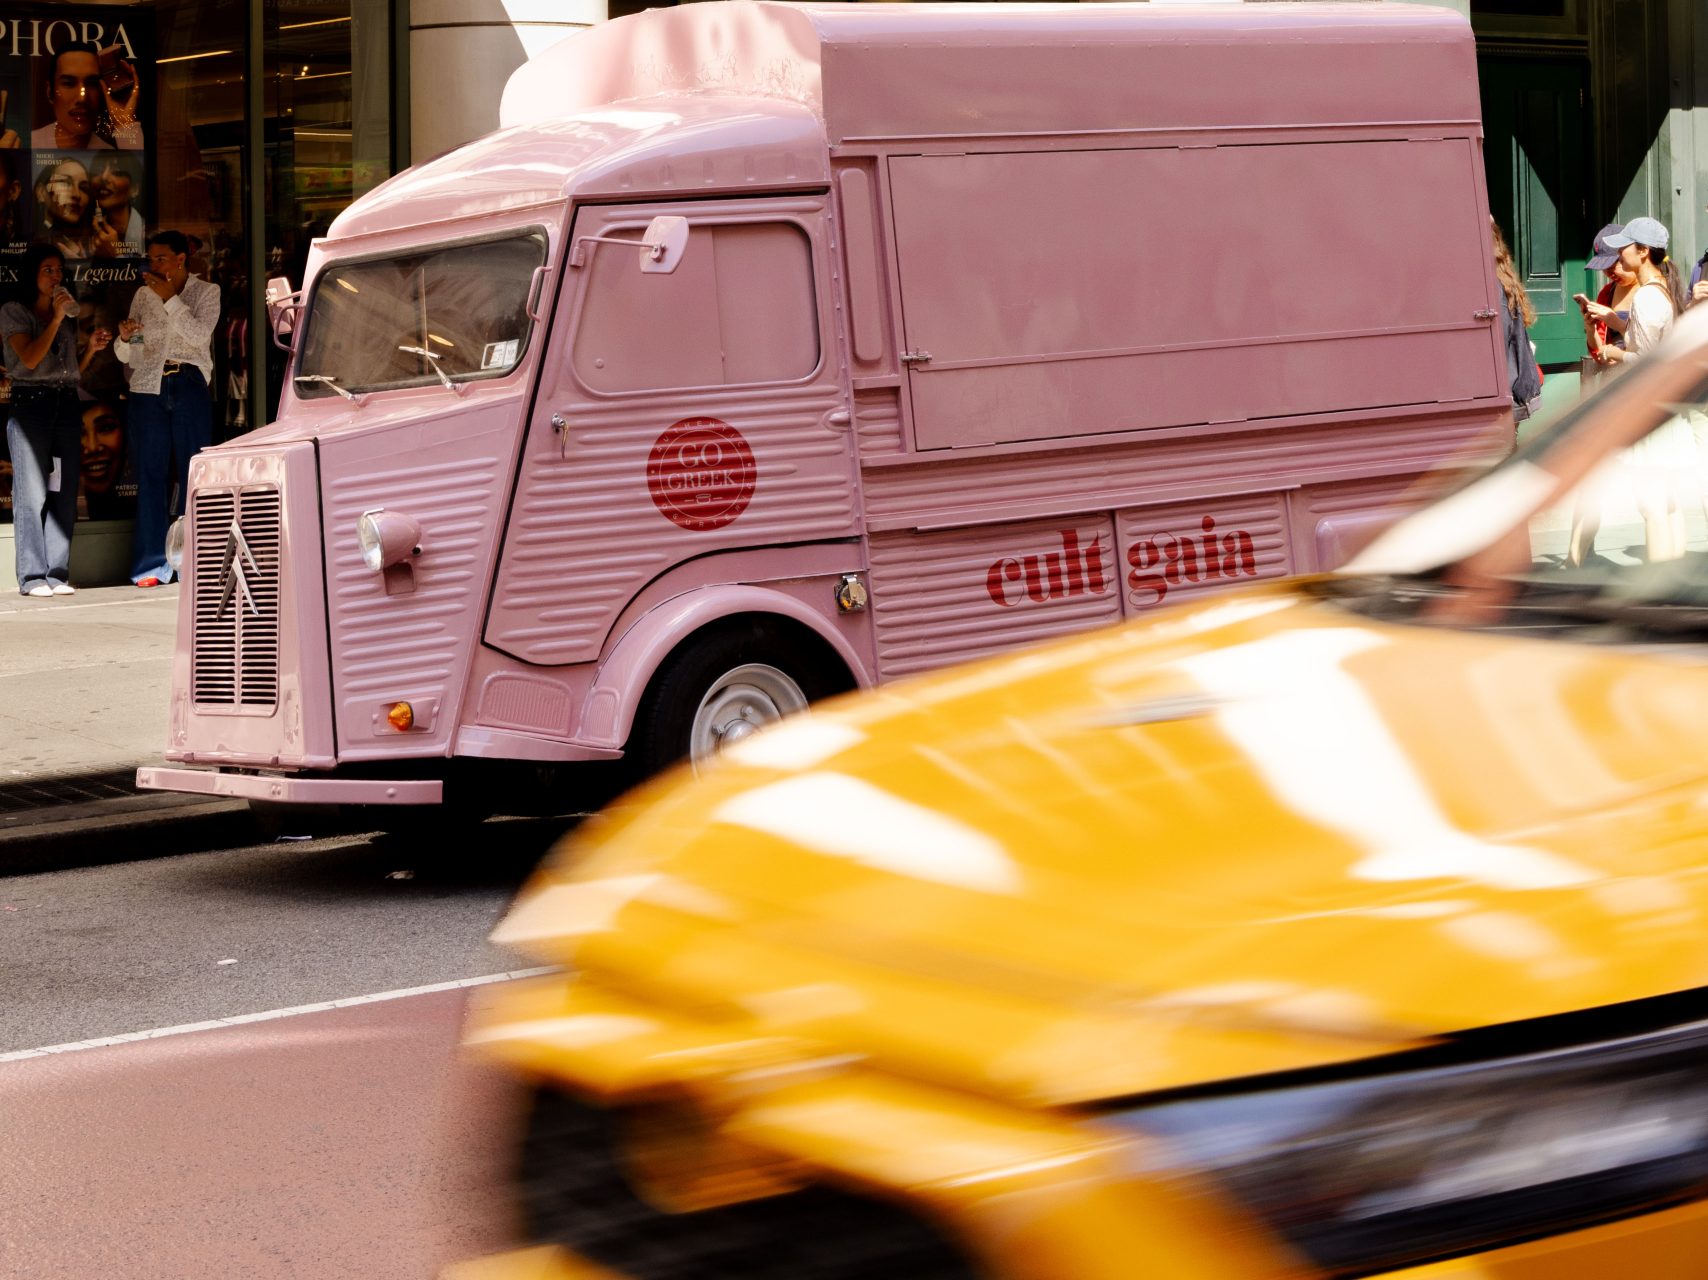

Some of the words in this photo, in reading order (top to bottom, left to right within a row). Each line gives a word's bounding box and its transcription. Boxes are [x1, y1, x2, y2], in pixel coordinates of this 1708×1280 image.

[0, 19, 139, 59] HORA
[73, 263, 138, 286] Legends
[678, 441, 723, 468] GO
[667, 469, 738, 490] GREEK
[986, 528, 1110, 607] cult
[1127, 515, 1257, 607] gaia
